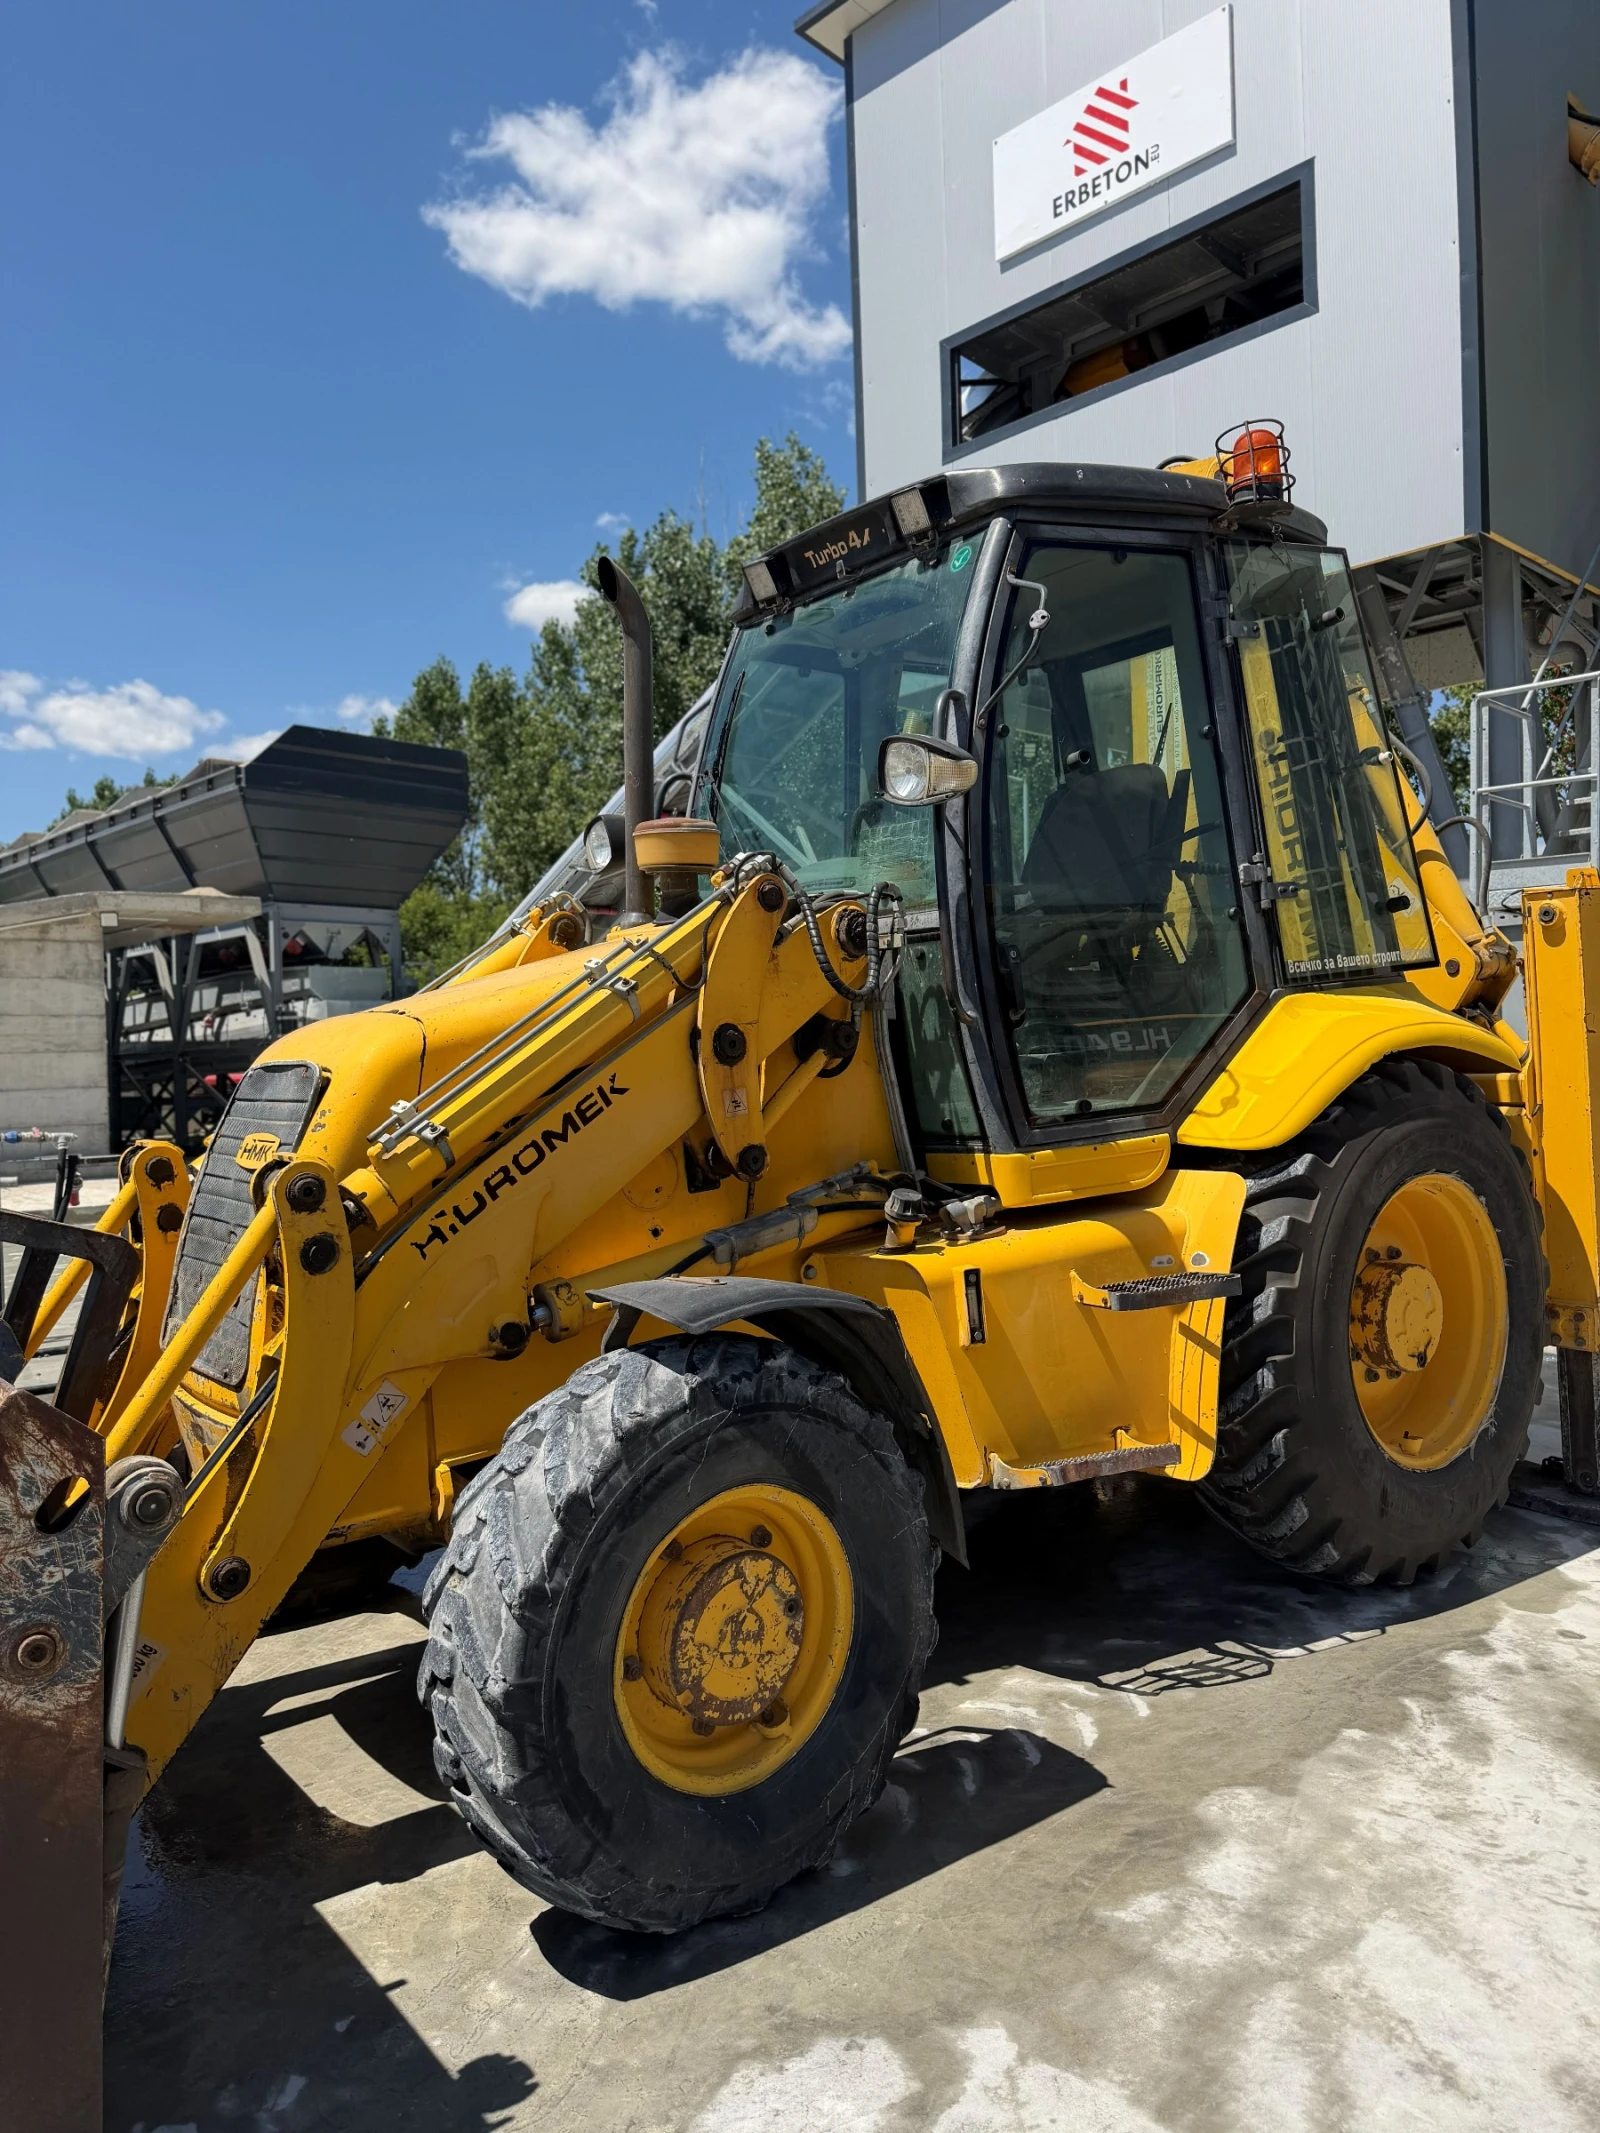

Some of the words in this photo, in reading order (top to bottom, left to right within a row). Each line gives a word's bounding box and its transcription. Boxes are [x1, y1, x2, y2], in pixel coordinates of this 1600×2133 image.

[1053, 148, 1149, 219] ERBETON
[804, 540, 849, 569] Turbo
[1287, 959, 1322, 974] Всичко
[1324, 958, 1336, 970] за
[1336, 953, 1371, 968] Вашето
[240, 1143, 272, 1162] HMK
[136, 1643, 158, 1659] kg
